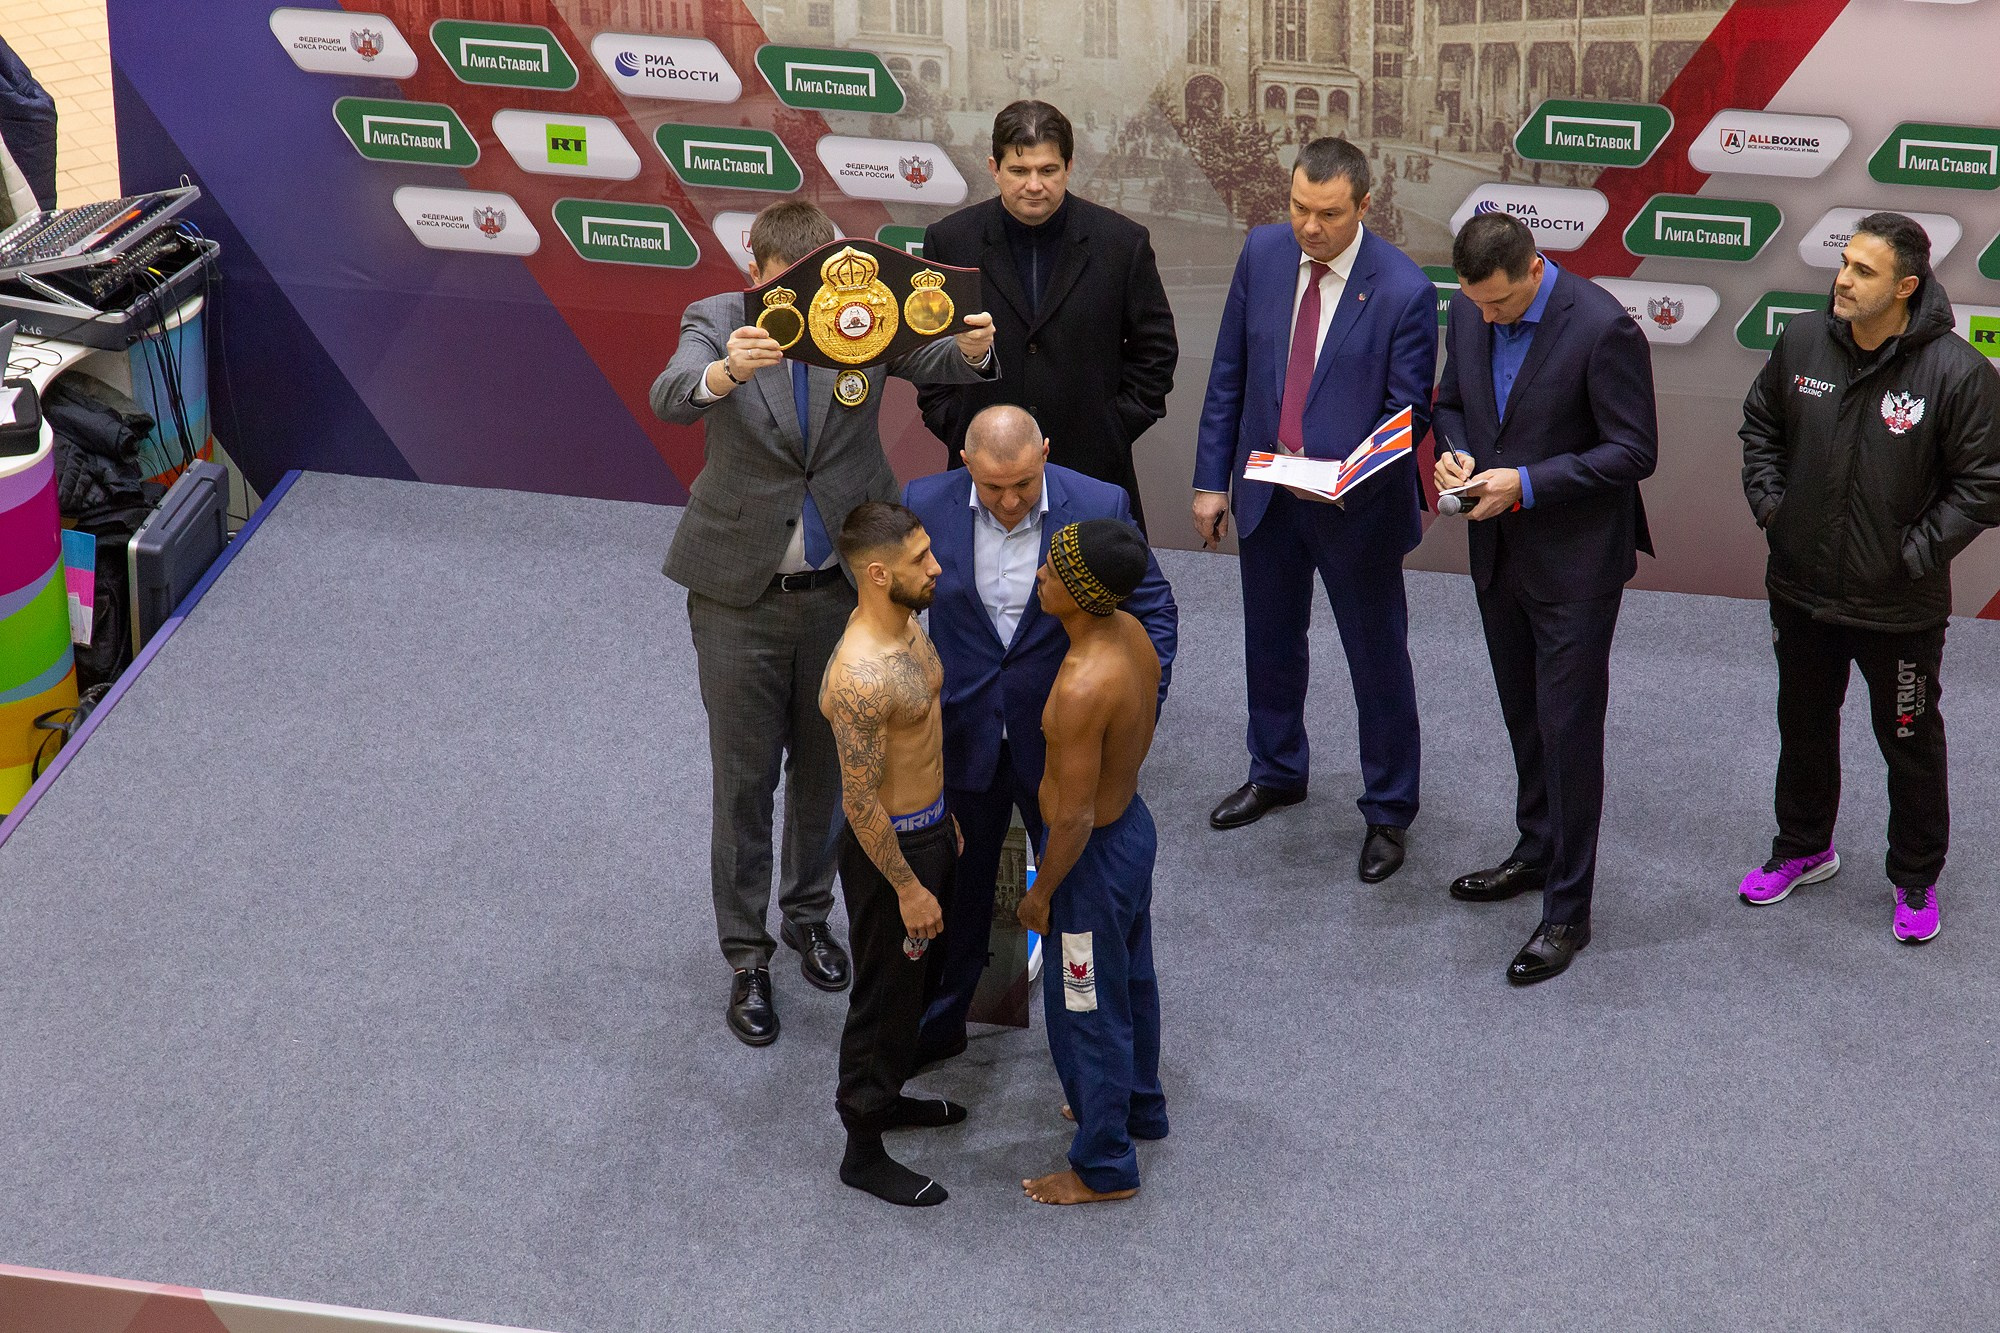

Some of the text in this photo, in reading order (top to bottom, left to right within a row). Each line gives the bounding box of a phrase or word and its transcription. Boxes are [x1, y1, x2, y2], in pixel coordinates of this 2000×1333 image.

[298, 36, 341, 44] ФЕДЕРАЦИЯ
[644, 54, 675, 66] РИА
[645, 67, 719, 82] НОВОСТИ
[551, 137, 586, 152] RT
[1748, 134, 1820, 147] ALLBOXING
[845, 163, 889, 171] ФЕДЕРАЦИЯ
[1506, 203, 1538, 215] РИА
[422, 213, 464, 222] ФЕДЕРАЦИЯ
[1519, 217, 1584, 232] ОВОСТИ
[1975, 330, 2000, 344] R
[1799, 386, 1823, 398] BOXING
[1916, 675, 1927, 716] BOXING
